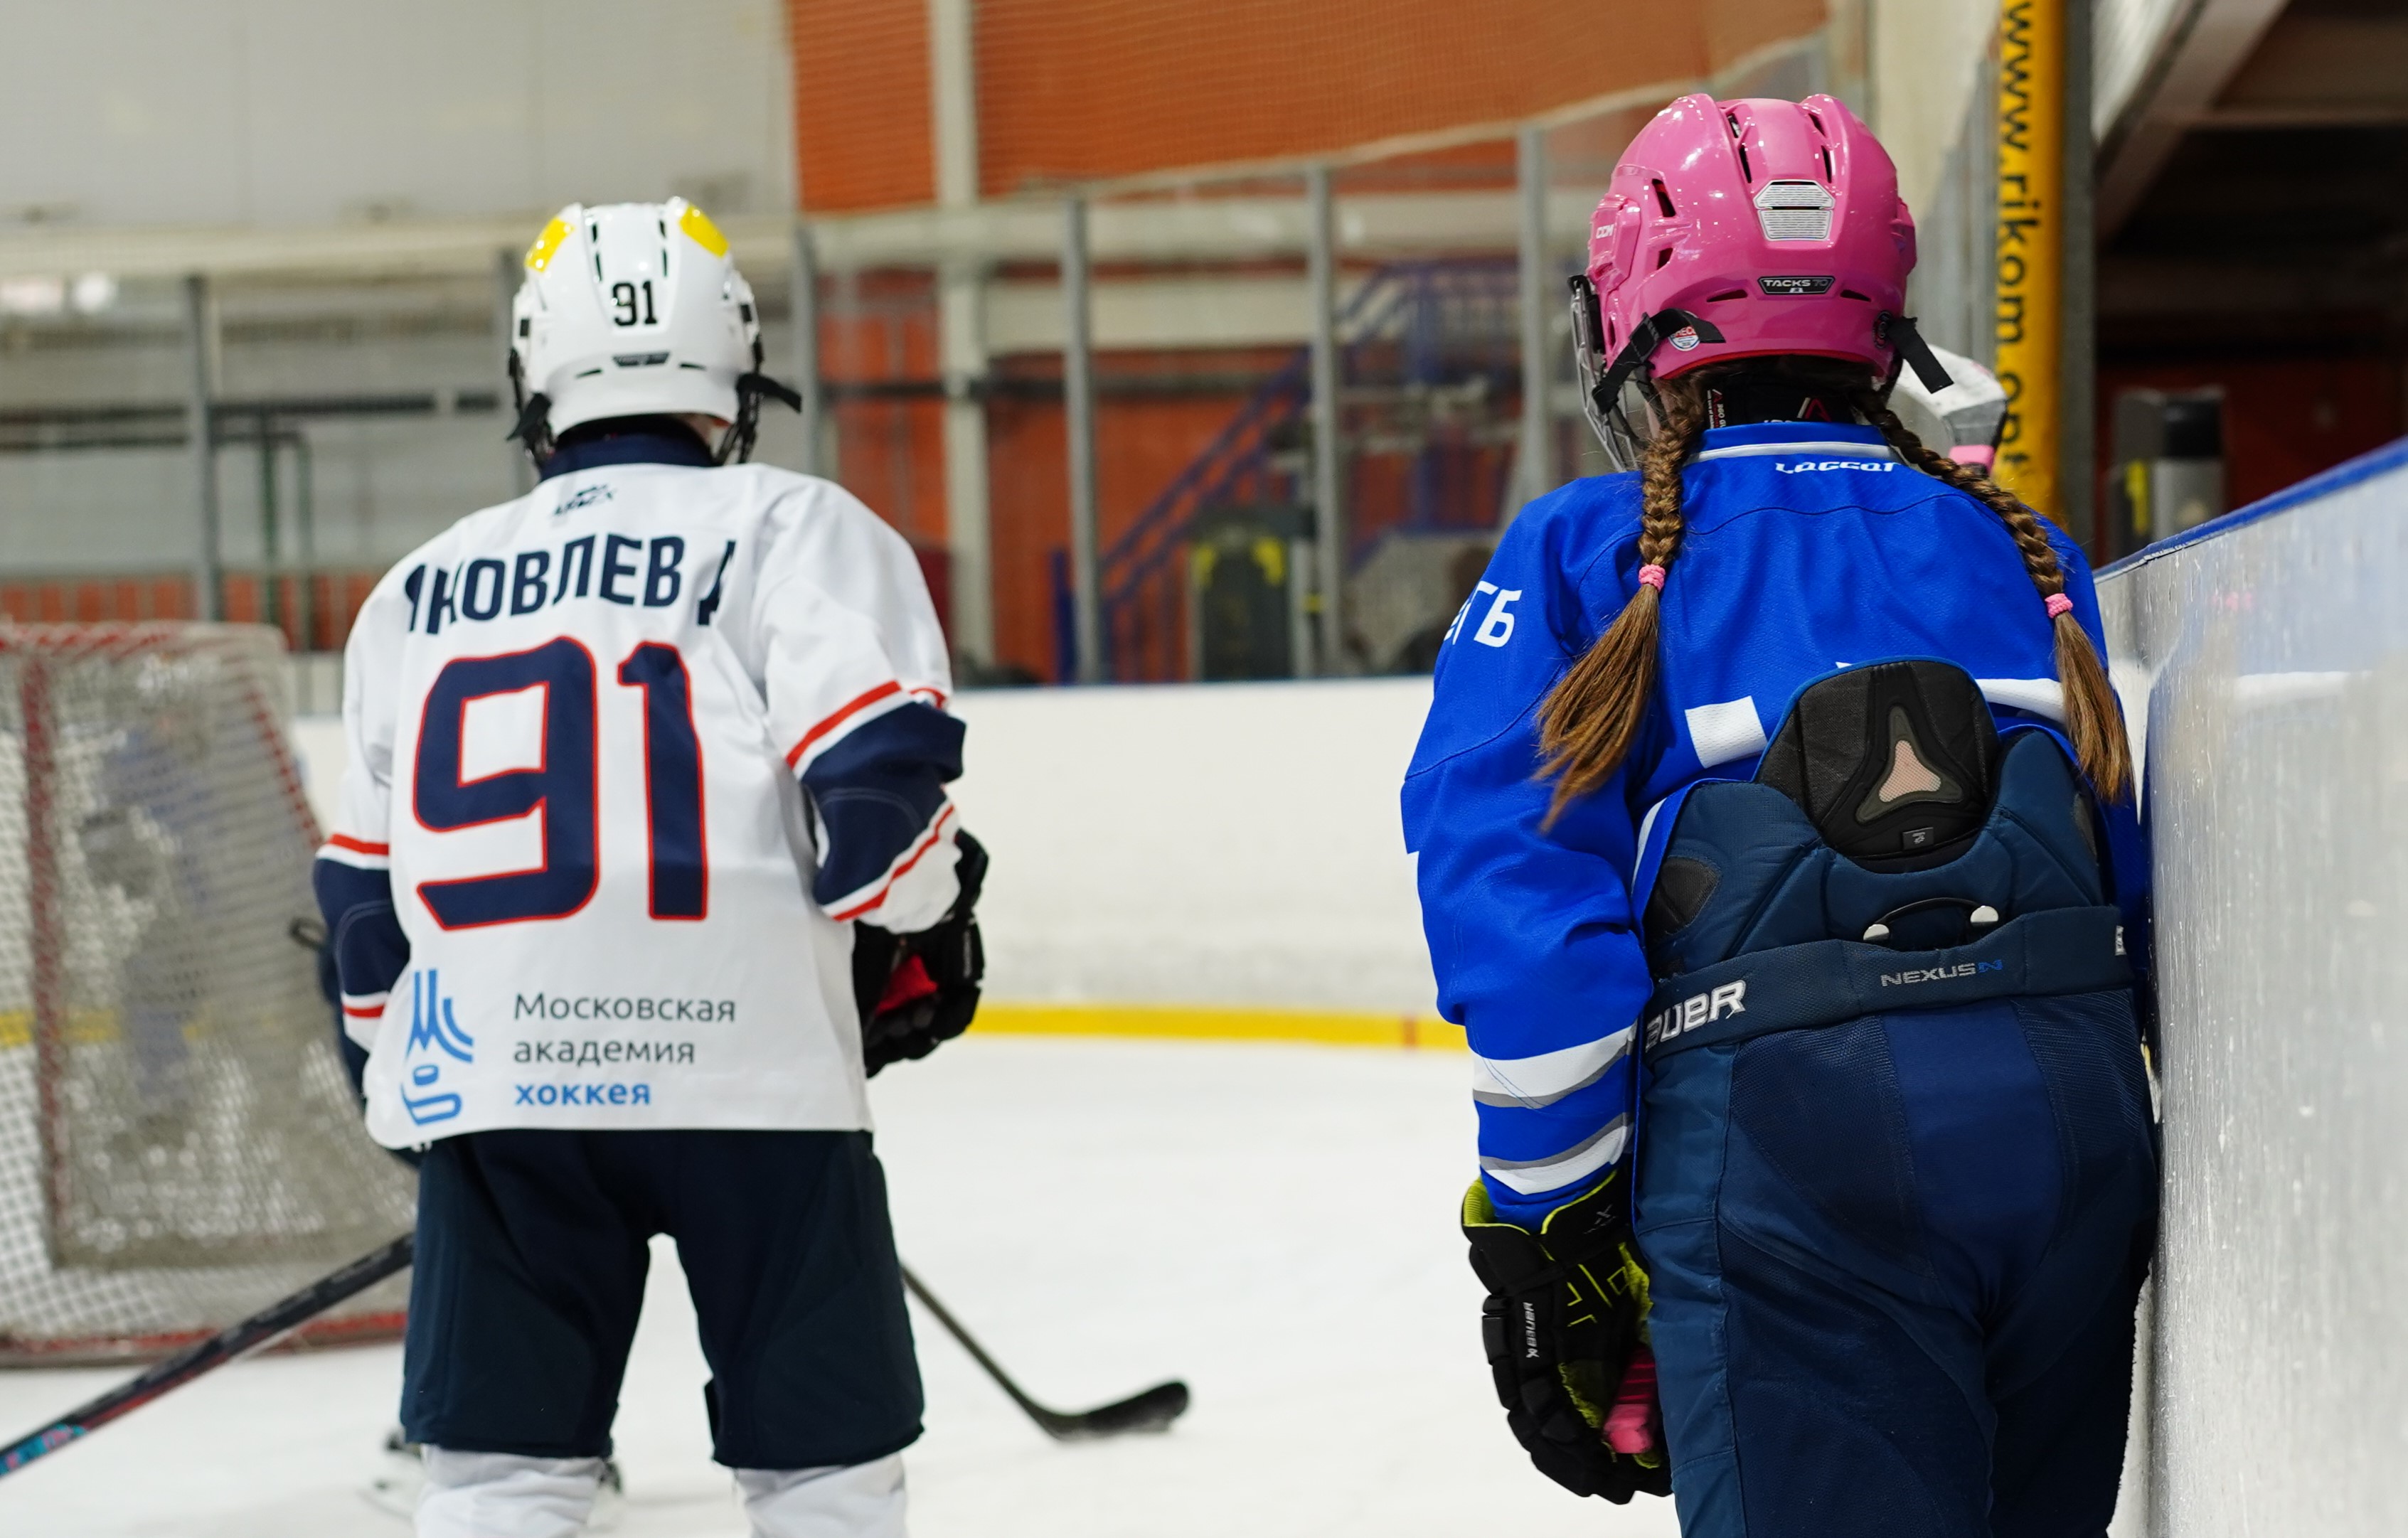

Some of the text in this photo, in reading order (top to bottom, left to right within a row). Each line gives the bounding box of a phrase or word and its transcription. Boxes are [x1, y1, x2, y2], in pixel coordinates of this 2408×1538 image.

[612, 281, 657, 326] 91
[412, 636, 708, 931] 91
[1880, 963, 1976, 987] NEXUS
[513, 993, 736, 1022] Московская
[513, 1040, 695, 1067] академия
[514, 1083, 651, 1106] хоккея
